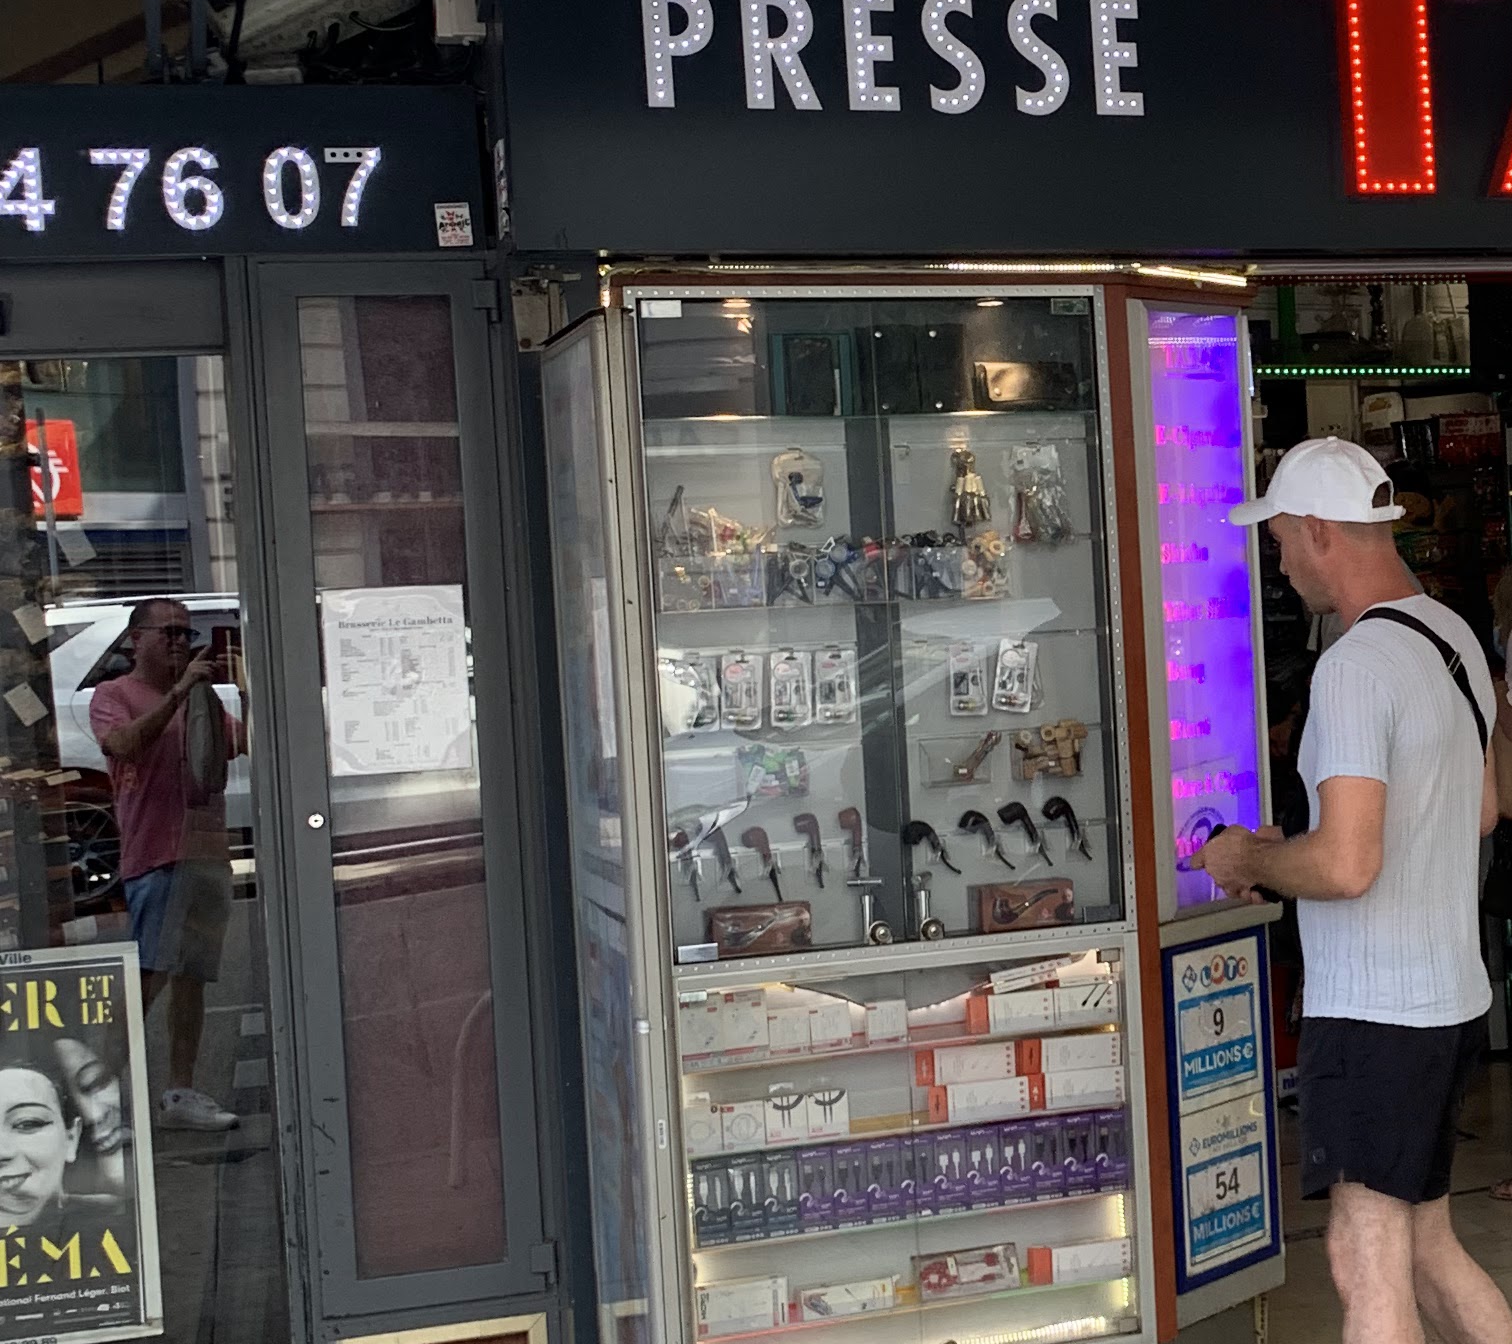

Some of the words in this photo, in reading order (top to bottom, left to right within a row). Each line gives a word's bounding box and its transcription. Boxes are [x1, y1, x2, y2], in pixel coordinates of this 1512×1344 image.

[88, 146, 225, 231] 76
[262, 145, 382, 230] 07
[80, 974, 114, 999] ET
[1200, 954, 1249, 988] LOTO
[82, 1000, 113, 1025] LE
[1213, 1007, 1225, 1036] 9
[1183, 1044, 1242, 1077] MILLIONS
[1202, 1121, 1258, 1149] EUROMILLIONS
[1215, 1167, 1240, 1200] 54
[1192, 1206, 1250, 1242] MILLIONS
[34, 1291, 77, 1303] Fernand
[110, 1284, 131, 1294] Biot
